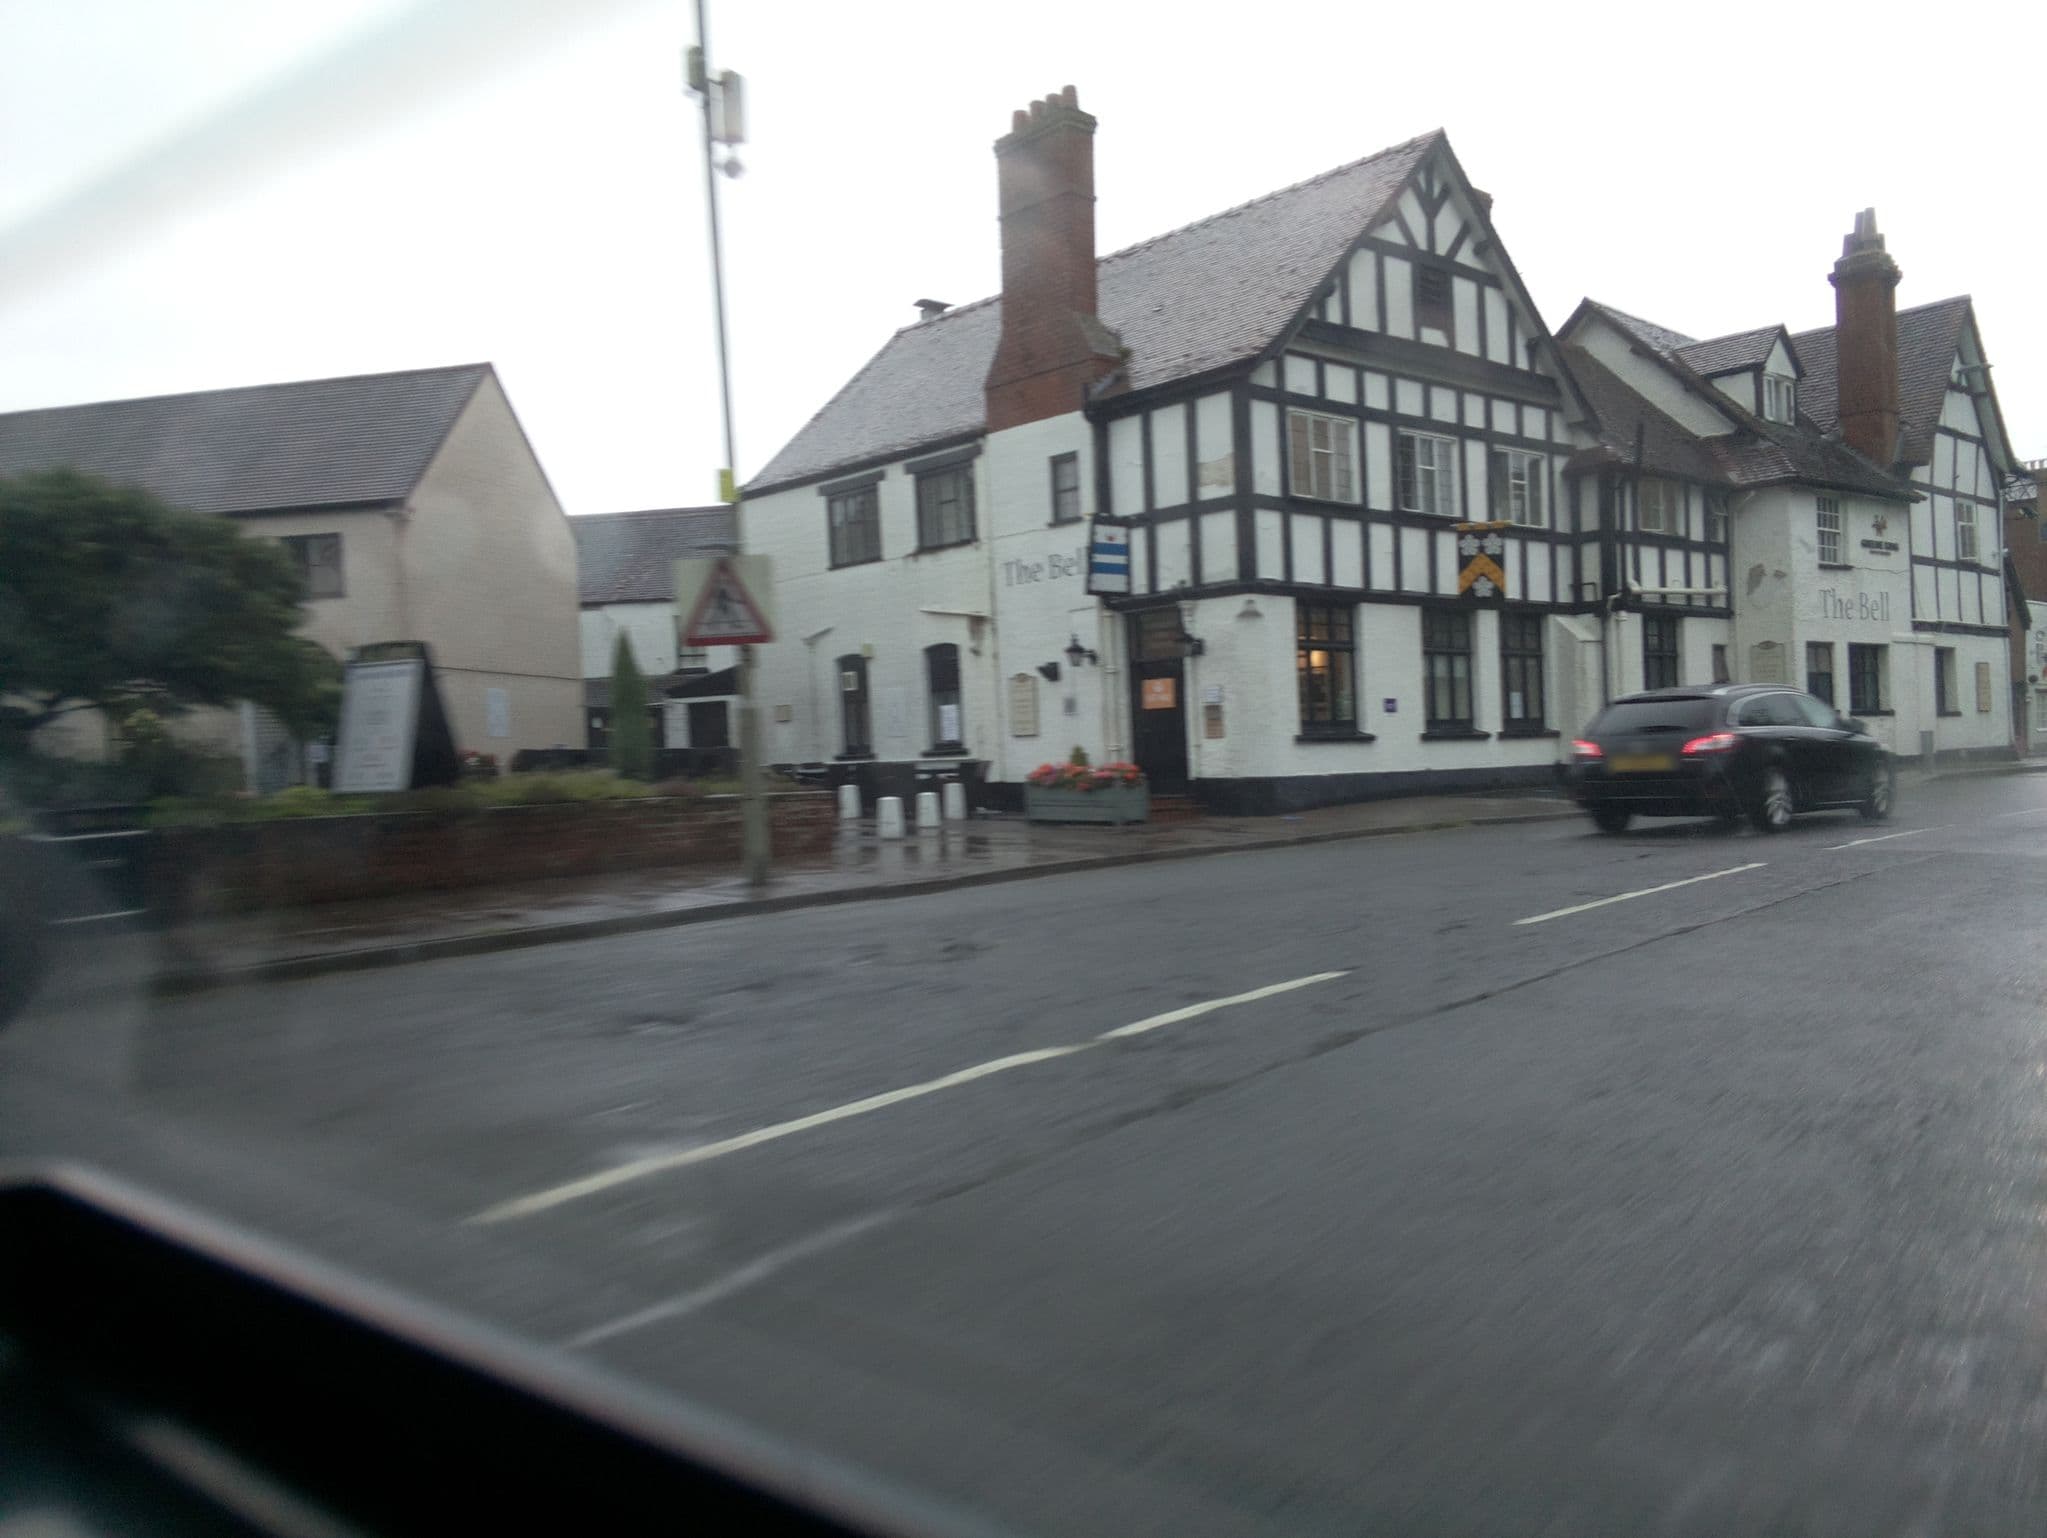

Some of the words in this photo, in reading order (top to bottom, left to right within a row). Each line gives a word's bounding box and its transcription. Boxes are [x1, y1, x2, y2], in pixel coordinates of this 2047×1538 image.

[1003, 558, 1043, 587] The
[1818, 587, 1854, 620] The
[1859, 591, 1889, 621] Bell
